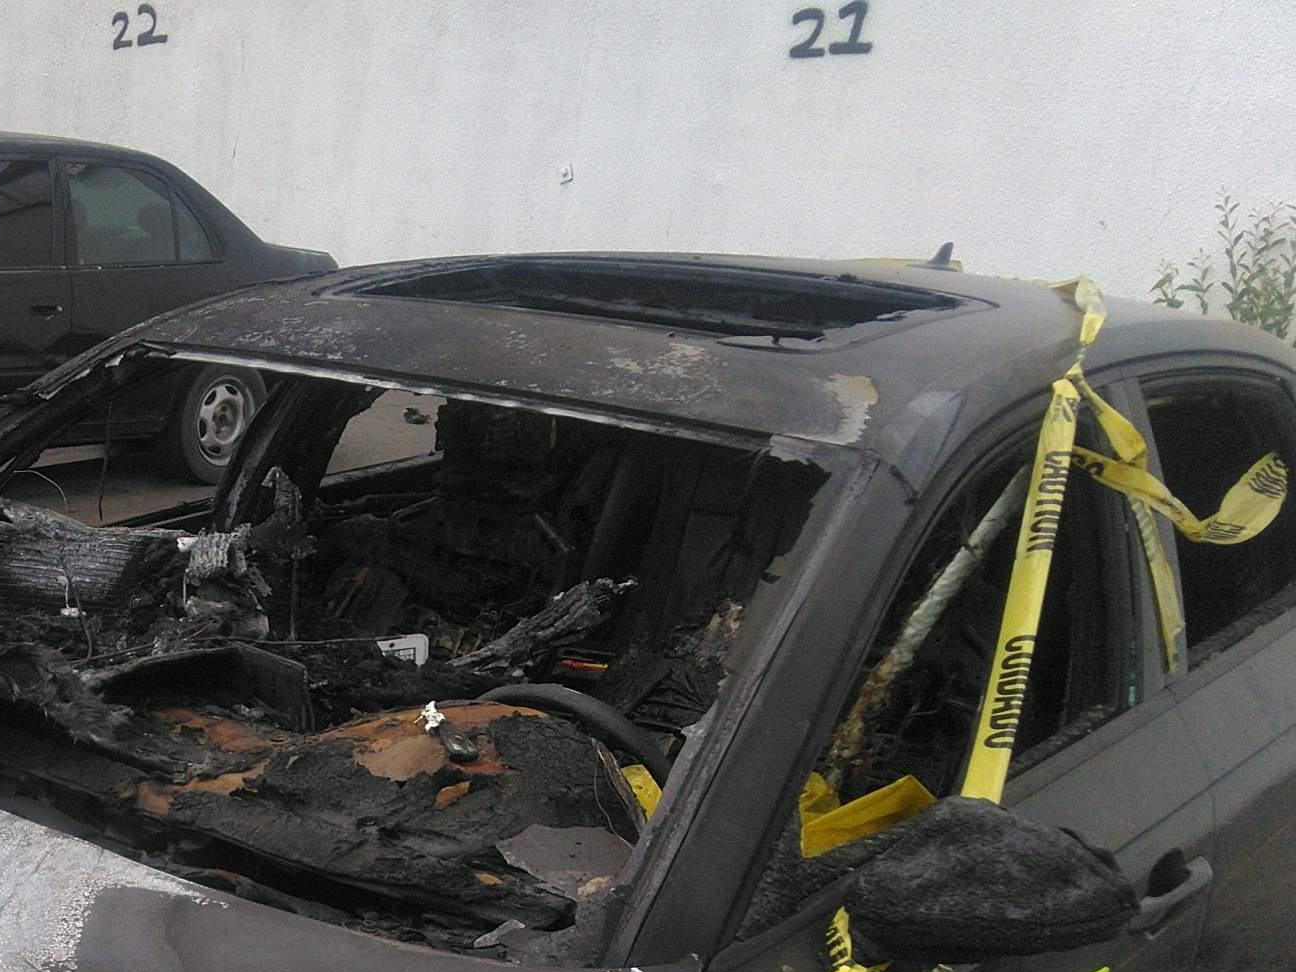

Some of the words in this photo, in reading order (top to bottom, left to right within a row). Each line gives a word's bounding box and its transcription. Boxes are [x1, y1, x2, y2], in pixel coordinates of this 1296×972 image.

[111, 4, 168, 50] 22
[789, 0, 873, 58] 21
[1027, 450, 1072, 553] CAUTION
